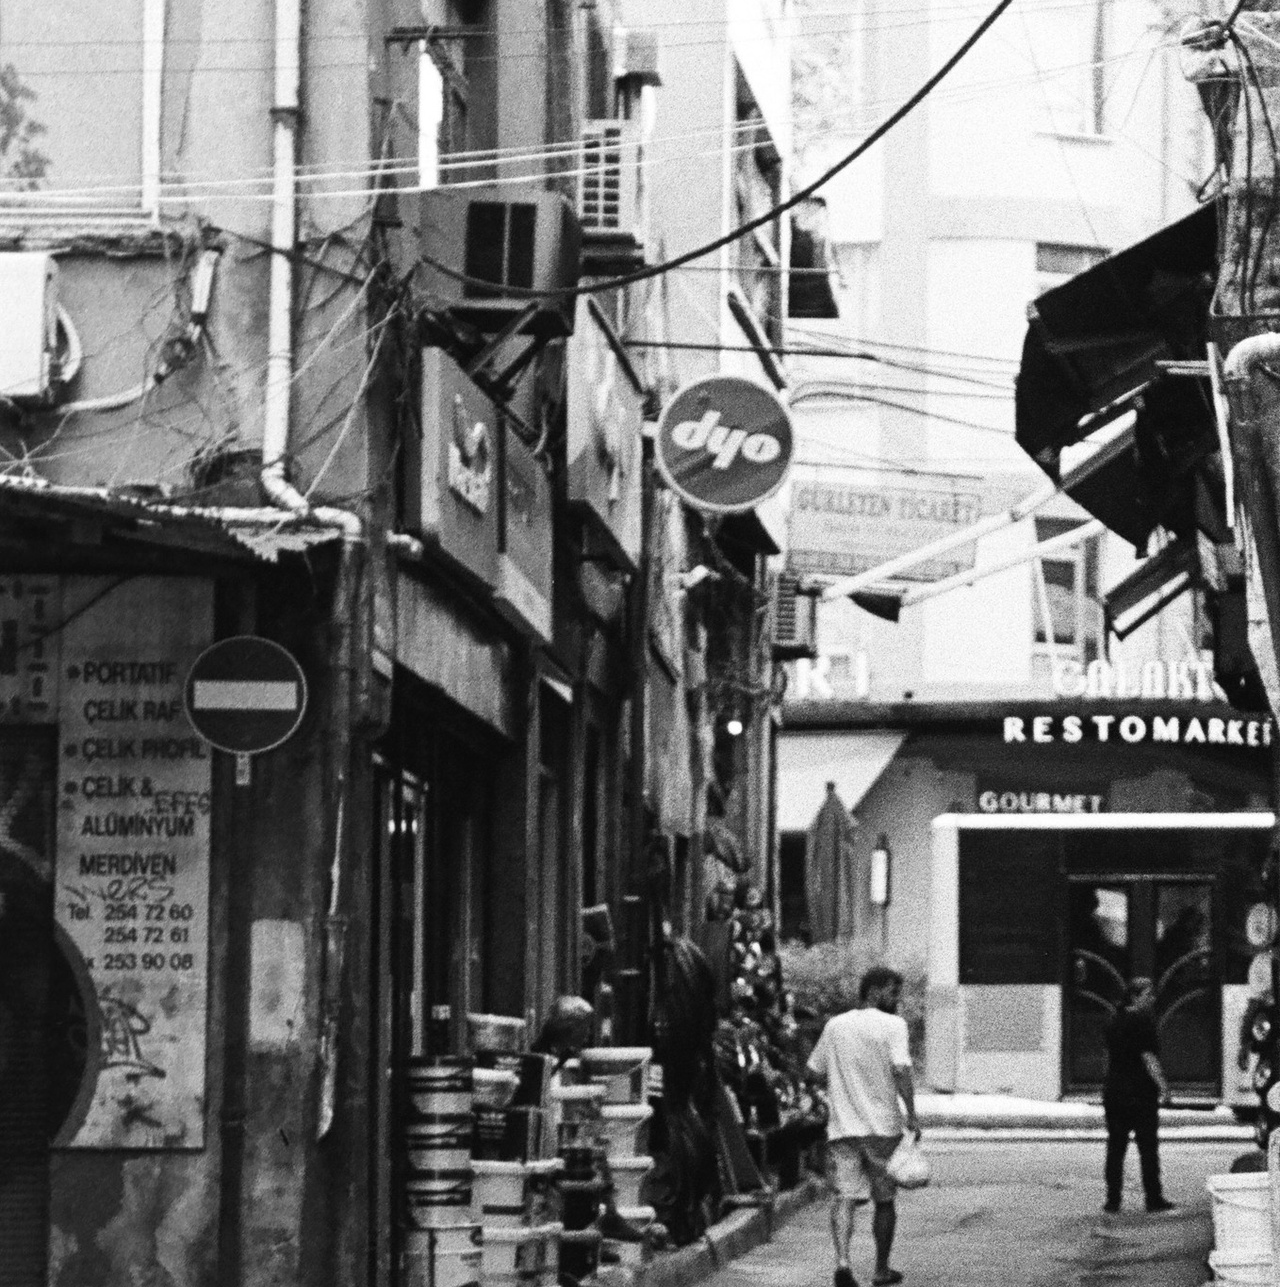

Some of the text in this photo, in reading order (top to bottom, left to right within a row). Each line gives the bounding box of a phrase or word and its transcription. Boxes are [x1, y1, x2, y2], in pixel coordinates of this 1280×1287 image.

[142, 699, 183, 722] RAF
[978, 789, 1103, 814] GOURMET
[81, 810, 195, 837] ALÜMİNYUM
[79, 851, 178, 876] MERDİVEN
[104, 903, 138, 921] 254
[144, 903, 165, 921] 72
[168, 902, 194, 921] 60
[104, 926, 190, 944] 254 72 61
[103, 953, 137, 970] 253
[142, 953, 165, 971] 90
[169, 952, 194, 971] 08
